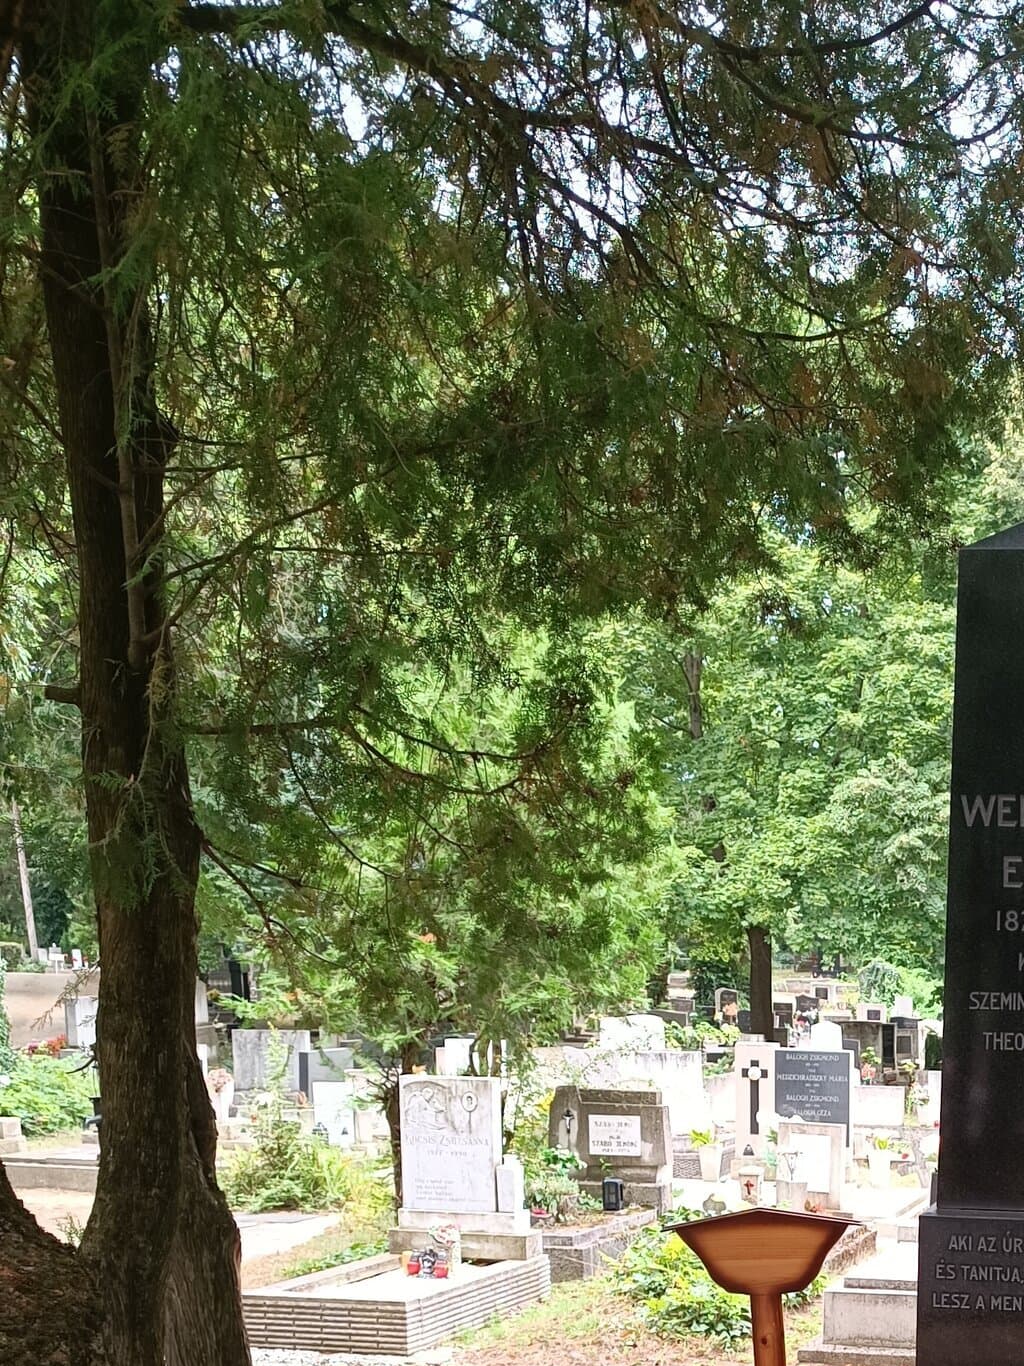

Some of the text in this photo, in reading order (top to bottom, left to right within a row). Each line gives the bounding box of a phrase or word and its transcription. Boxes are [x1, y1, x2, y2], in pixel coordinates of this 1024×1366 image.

[948, 1235, 972, 1251] AKI
[978, 1236, 997, 1252] AZ
[1002, 1231, 1023, 1253] ÚR
[936, 1259, 956, 1279] ÉS
[933, 1293, 970, 1309] LESZ
[976, 1295, 985, 1310] A
